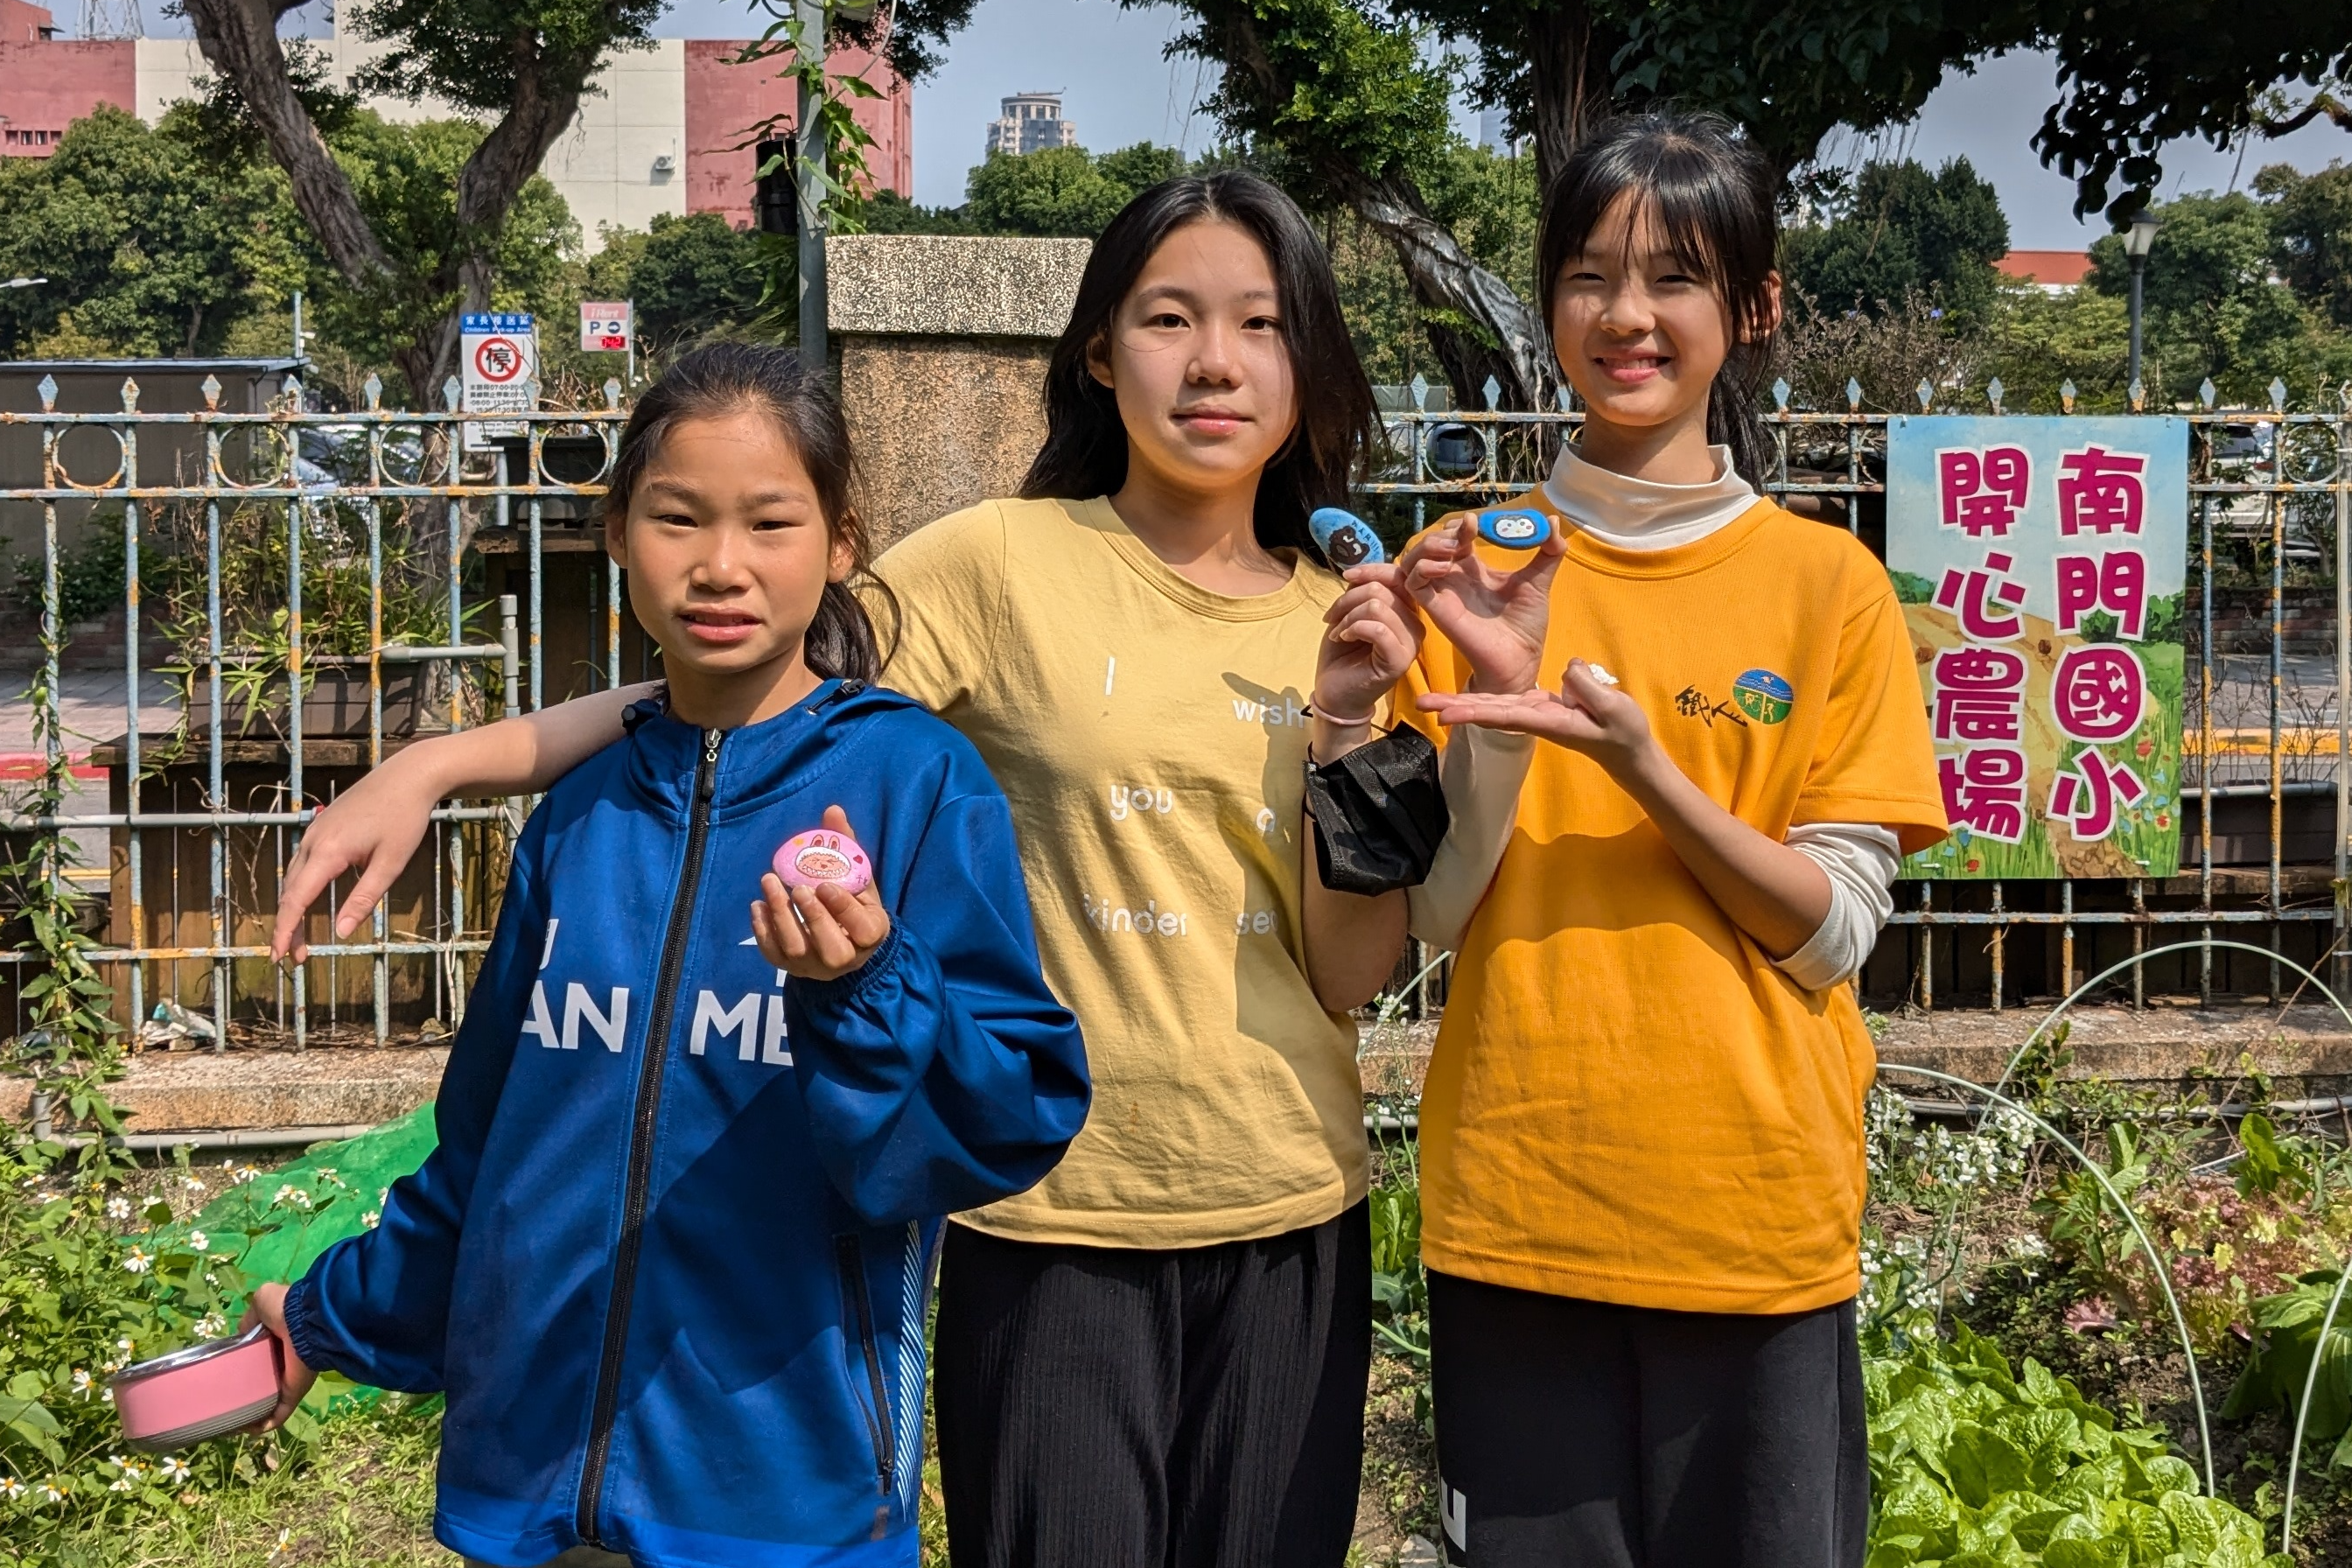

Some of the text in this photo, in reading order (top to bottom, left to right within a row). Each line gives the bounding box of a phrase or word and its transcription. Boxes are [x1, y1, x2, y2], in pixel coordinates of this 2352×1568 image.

[590, 321, 601, 335] P
[486, 346, 512, 373] 停
[1935, 445, 2032, 842] 開心農場
[2049, 444, 2148, 840] 南門國小
[1232, 696, 1305, 728] wish
[1110, 784, 1276, 832] you a
[1083, 893, 1187, 937] kinder
